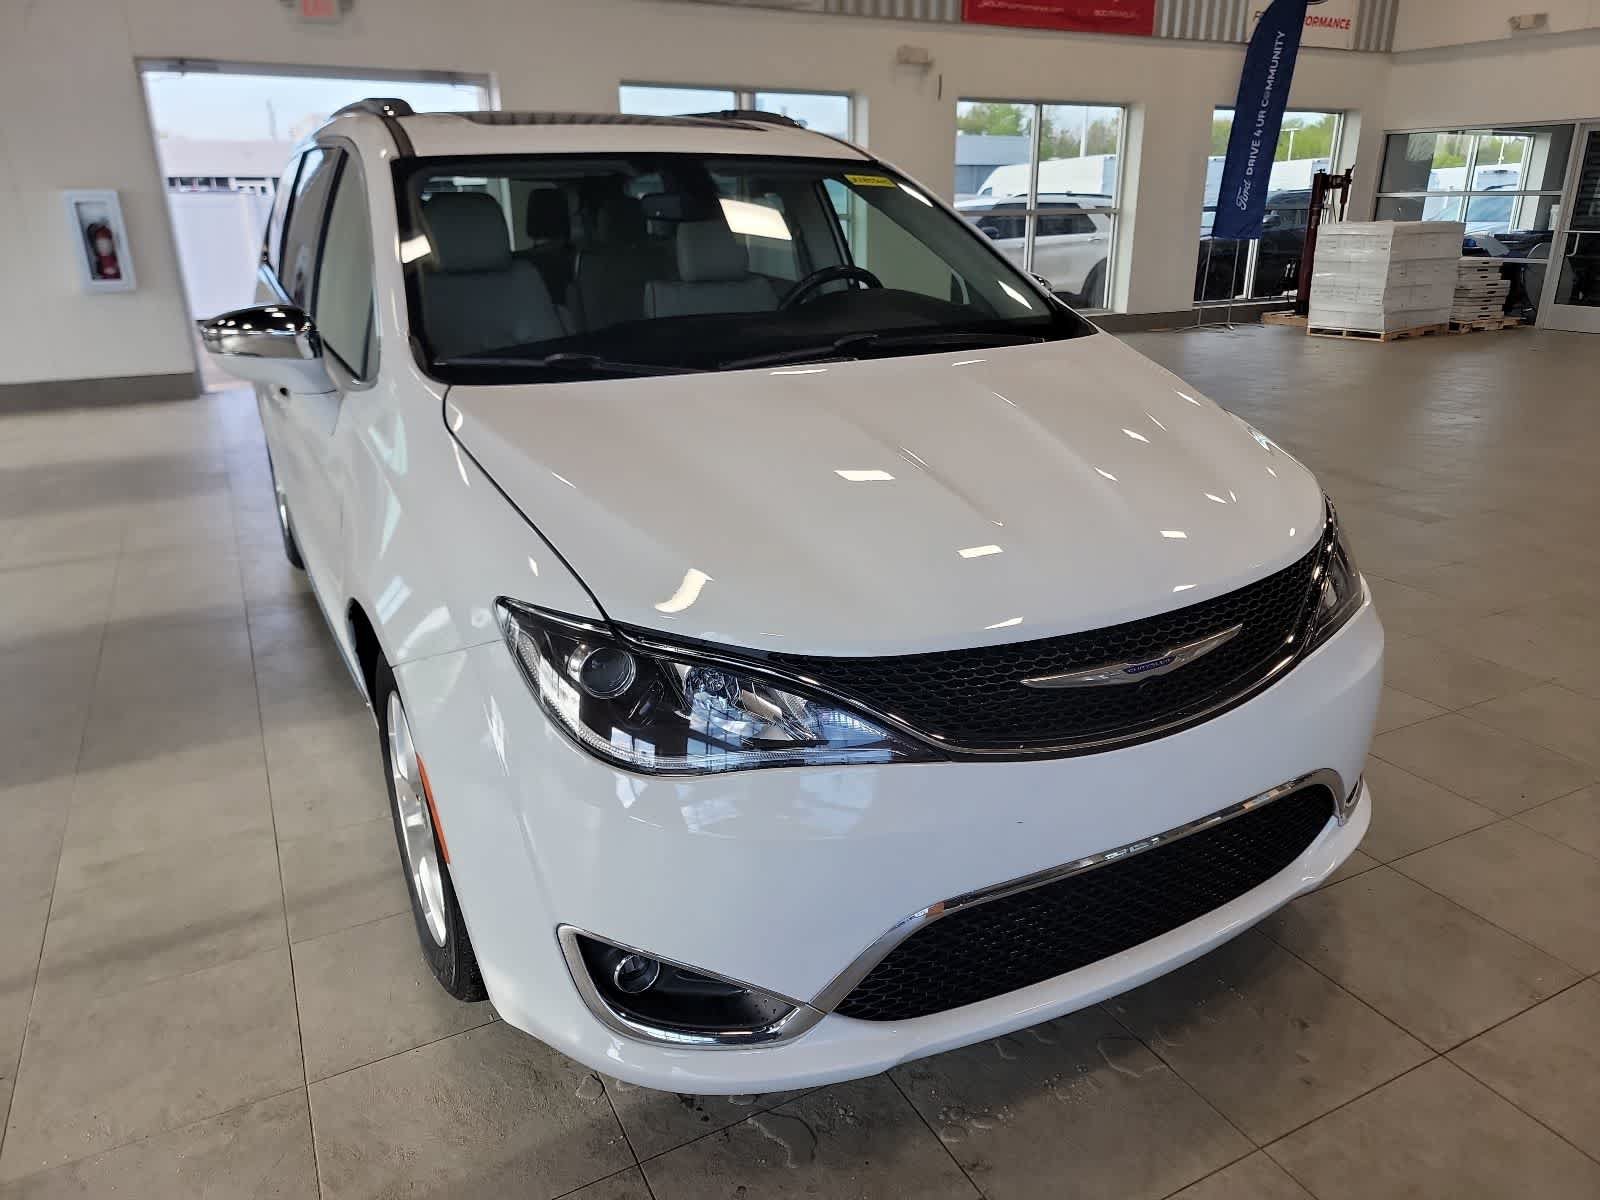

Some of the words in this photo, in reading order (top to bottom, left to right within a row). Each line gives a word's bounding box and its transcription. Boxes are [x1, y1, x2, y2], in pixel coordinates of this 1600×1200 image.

[1305, 16, 1351, 30] ORMANCE
[1236, 180, 1251, 211] Ford
[1246, 138, 1261, 176] DRIVE
[1256, 110, 1267, 128] UR
